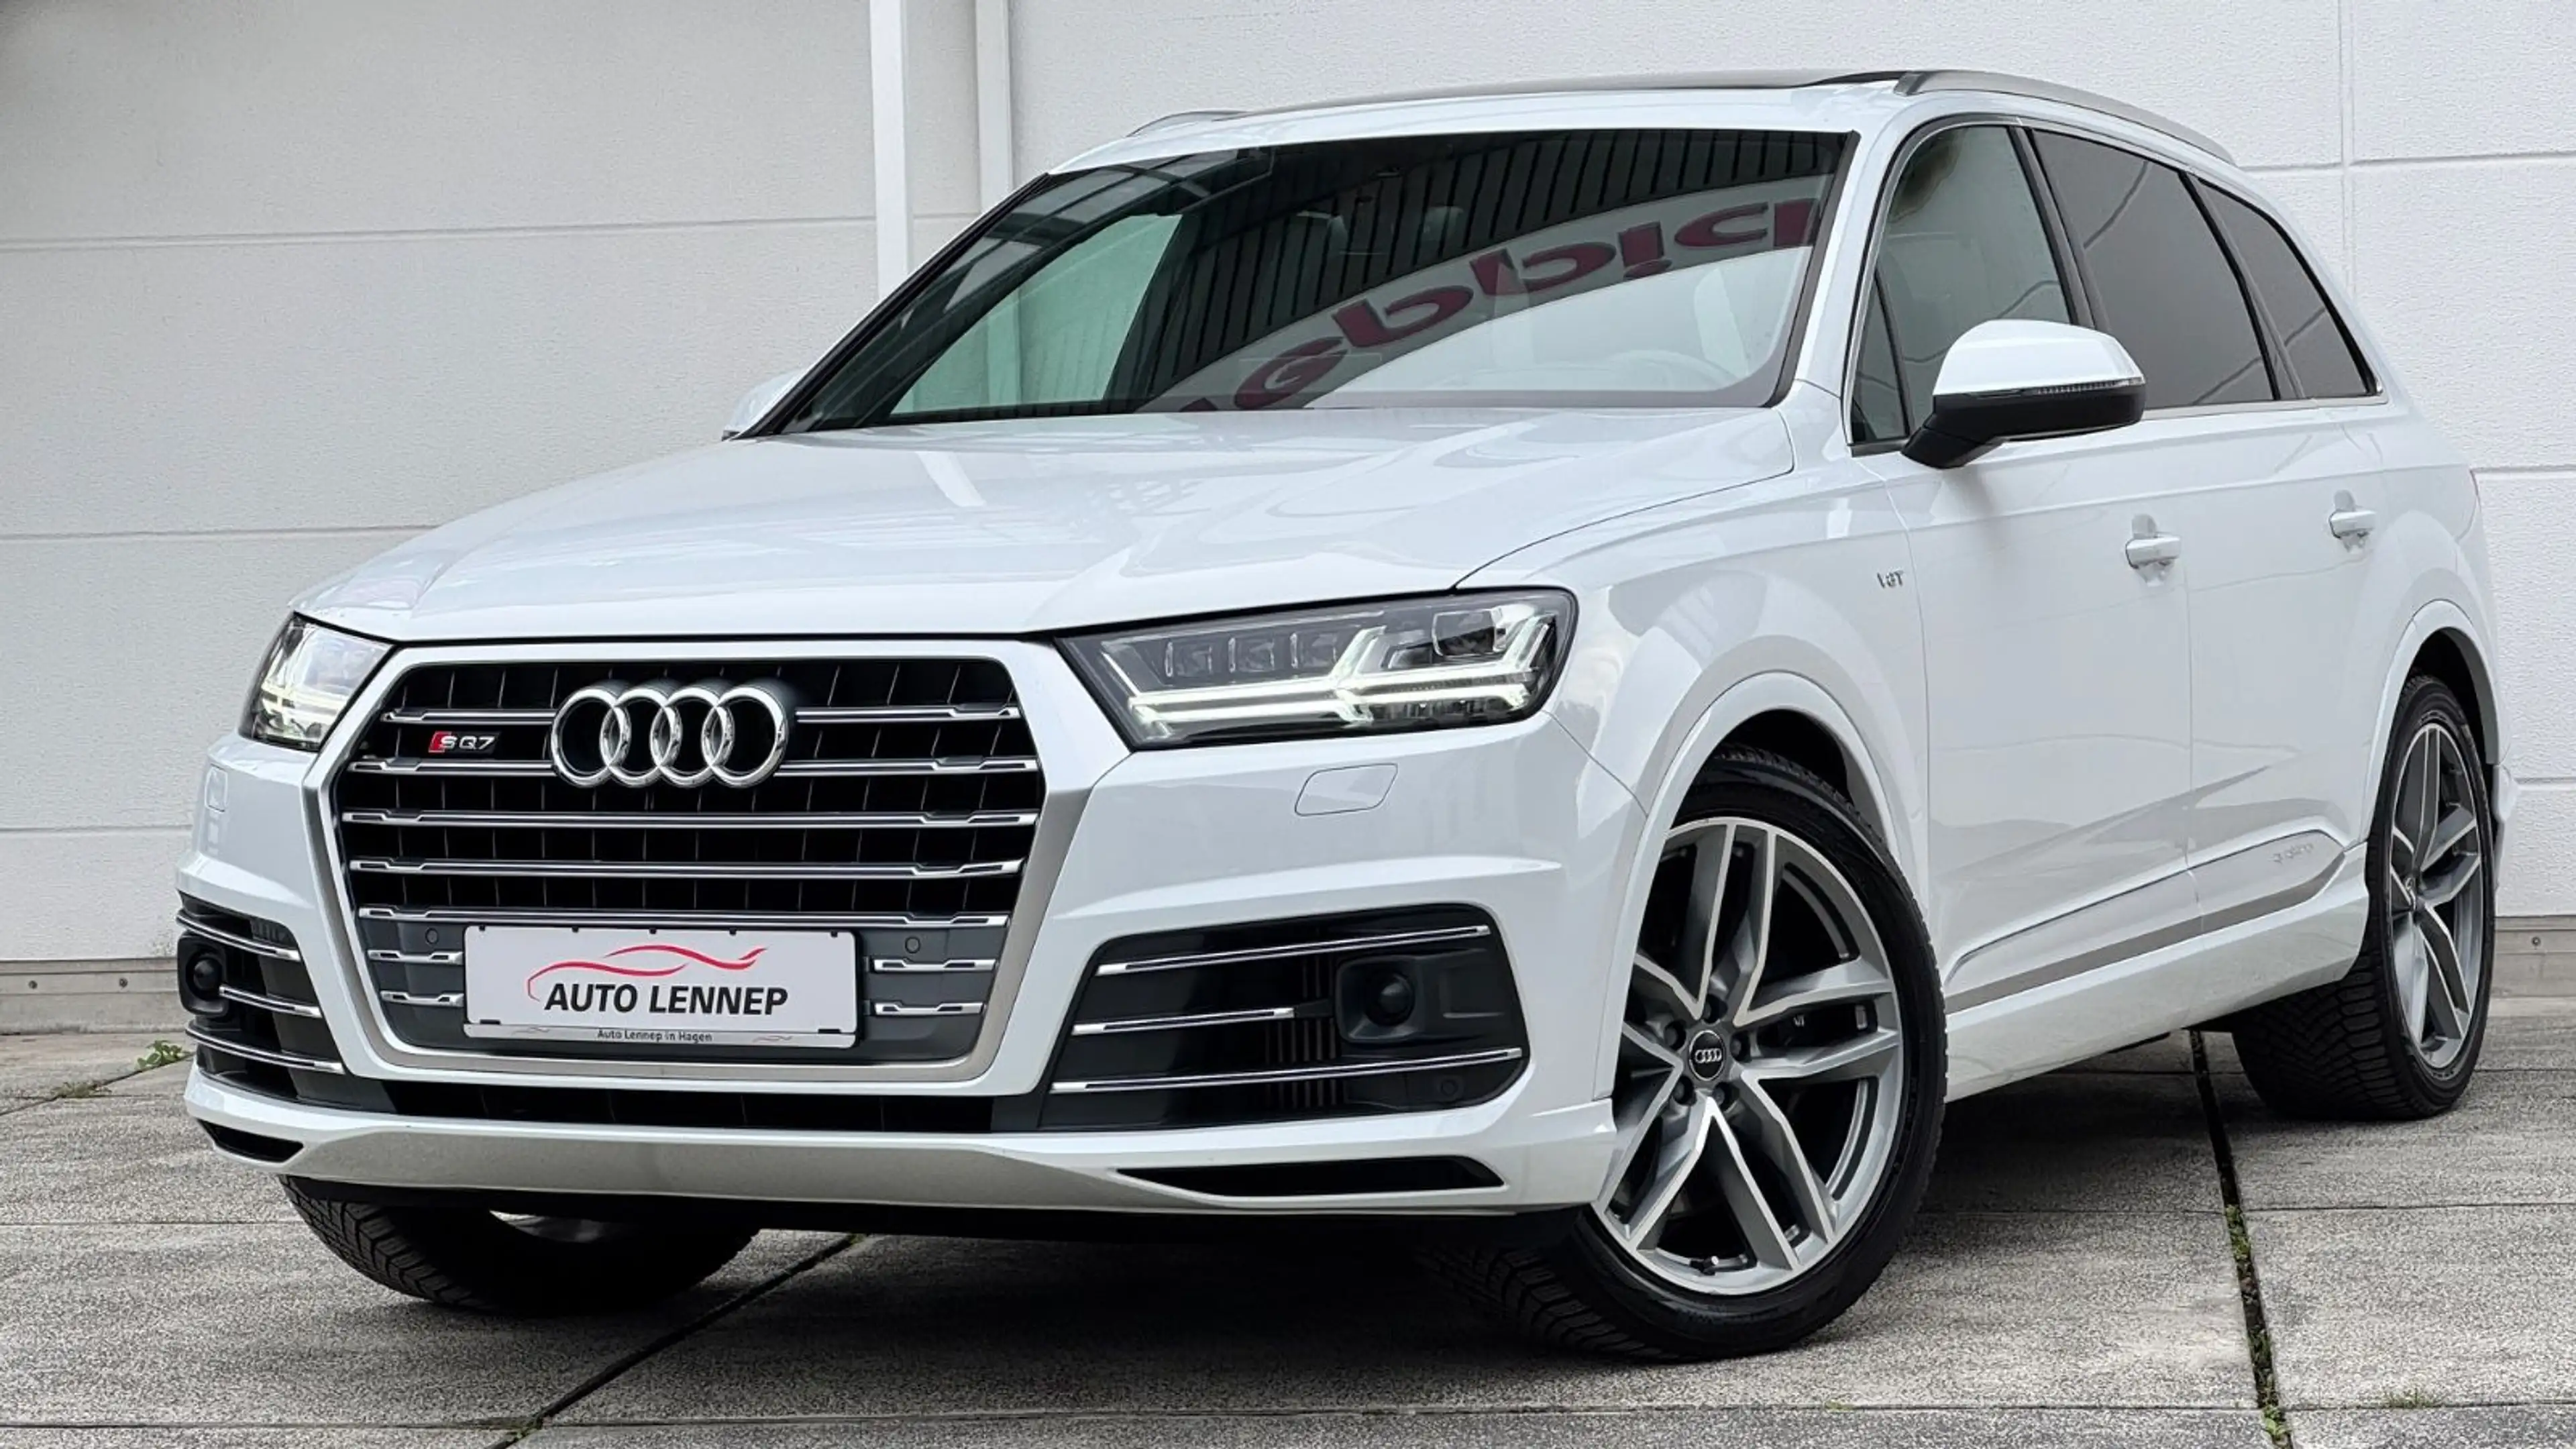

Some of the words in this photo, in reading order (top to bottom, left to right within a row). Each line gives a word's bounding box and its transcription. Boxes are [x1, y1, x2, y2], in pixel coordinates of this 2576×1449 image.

[439, 735, 496, 749] SQ7
[545, 983, 638, 1012] AUTO
[649, 985, 788, 1015] LENNEP
[598, 1029, 622, 1039] Auto
[625, 1030, 663, 1042] Lennep
[665, 1032, 675, 1040] in
[679, 1032, 712, 1044] Hagen
